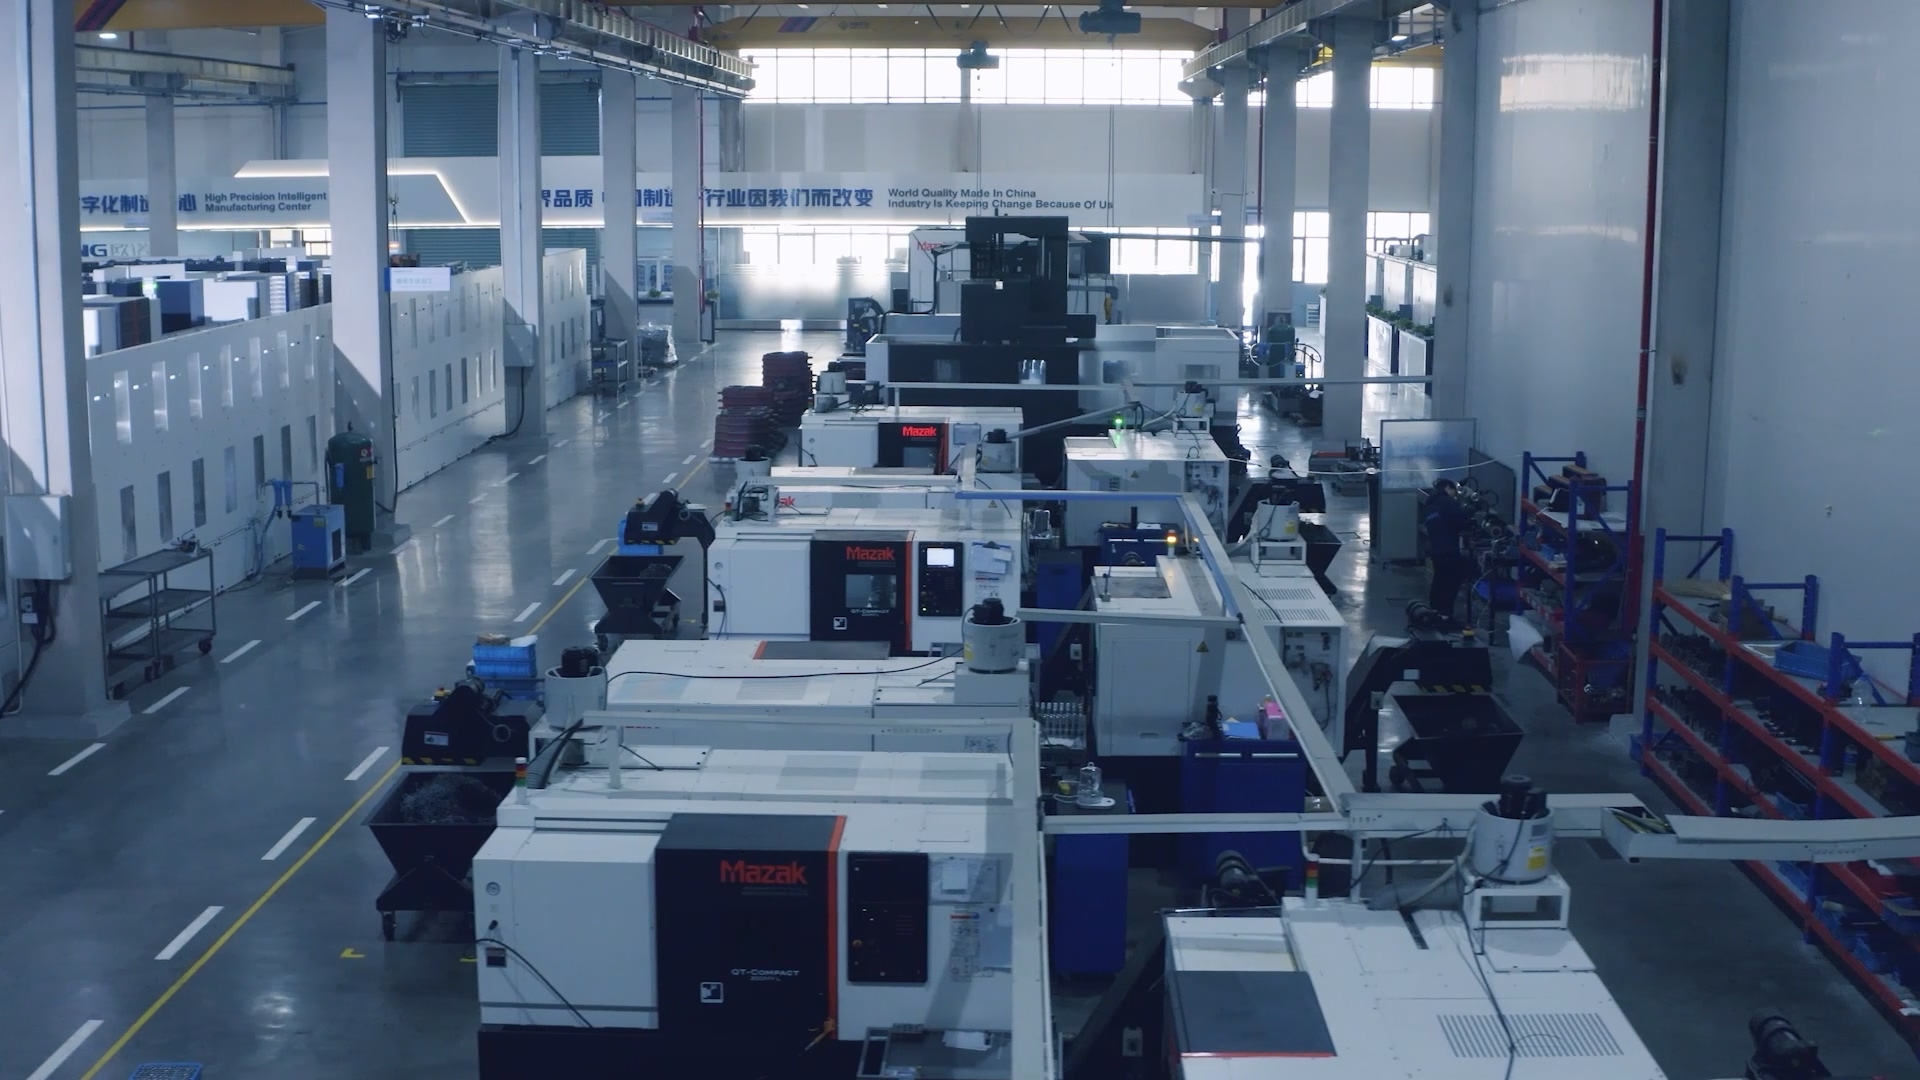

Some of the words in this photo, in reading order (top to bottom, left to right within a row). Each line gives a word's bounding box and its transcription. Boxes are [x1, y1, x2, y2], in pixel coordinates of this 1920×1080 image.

[204, 193, 227, 203] High
[229, 192, 276, 202] Precision
[277, 191, 327, 203] Intelligent
[705, 188, 873, 208] 行业因我们而改变
[888, 188, 919, 198] World
[921, 188, 958, 200] Quality
[960, 188, 990, 198] Made
[993, 188, 1003, 198] In
[1005, 189, 1036, 198] China
[205, 202, 275, 213] Manufacturing
[278, 202, 312, 212] Center
[888, 199, 931, 210] Industry
[933, 199, 943, 209] Is
[945, 199, 988, 210] Keeping
[991, 200, 1034, 210] Change
[1035, 200, 1081, 209] Because
[1084, 200, 1097, 209] Of
[1099, 200, 1114, 209] Us
[902, 426, 937, 437] Mazak
[845, 546, 896, 561] Mazak
[719, 860, 808, 885] Mazak
